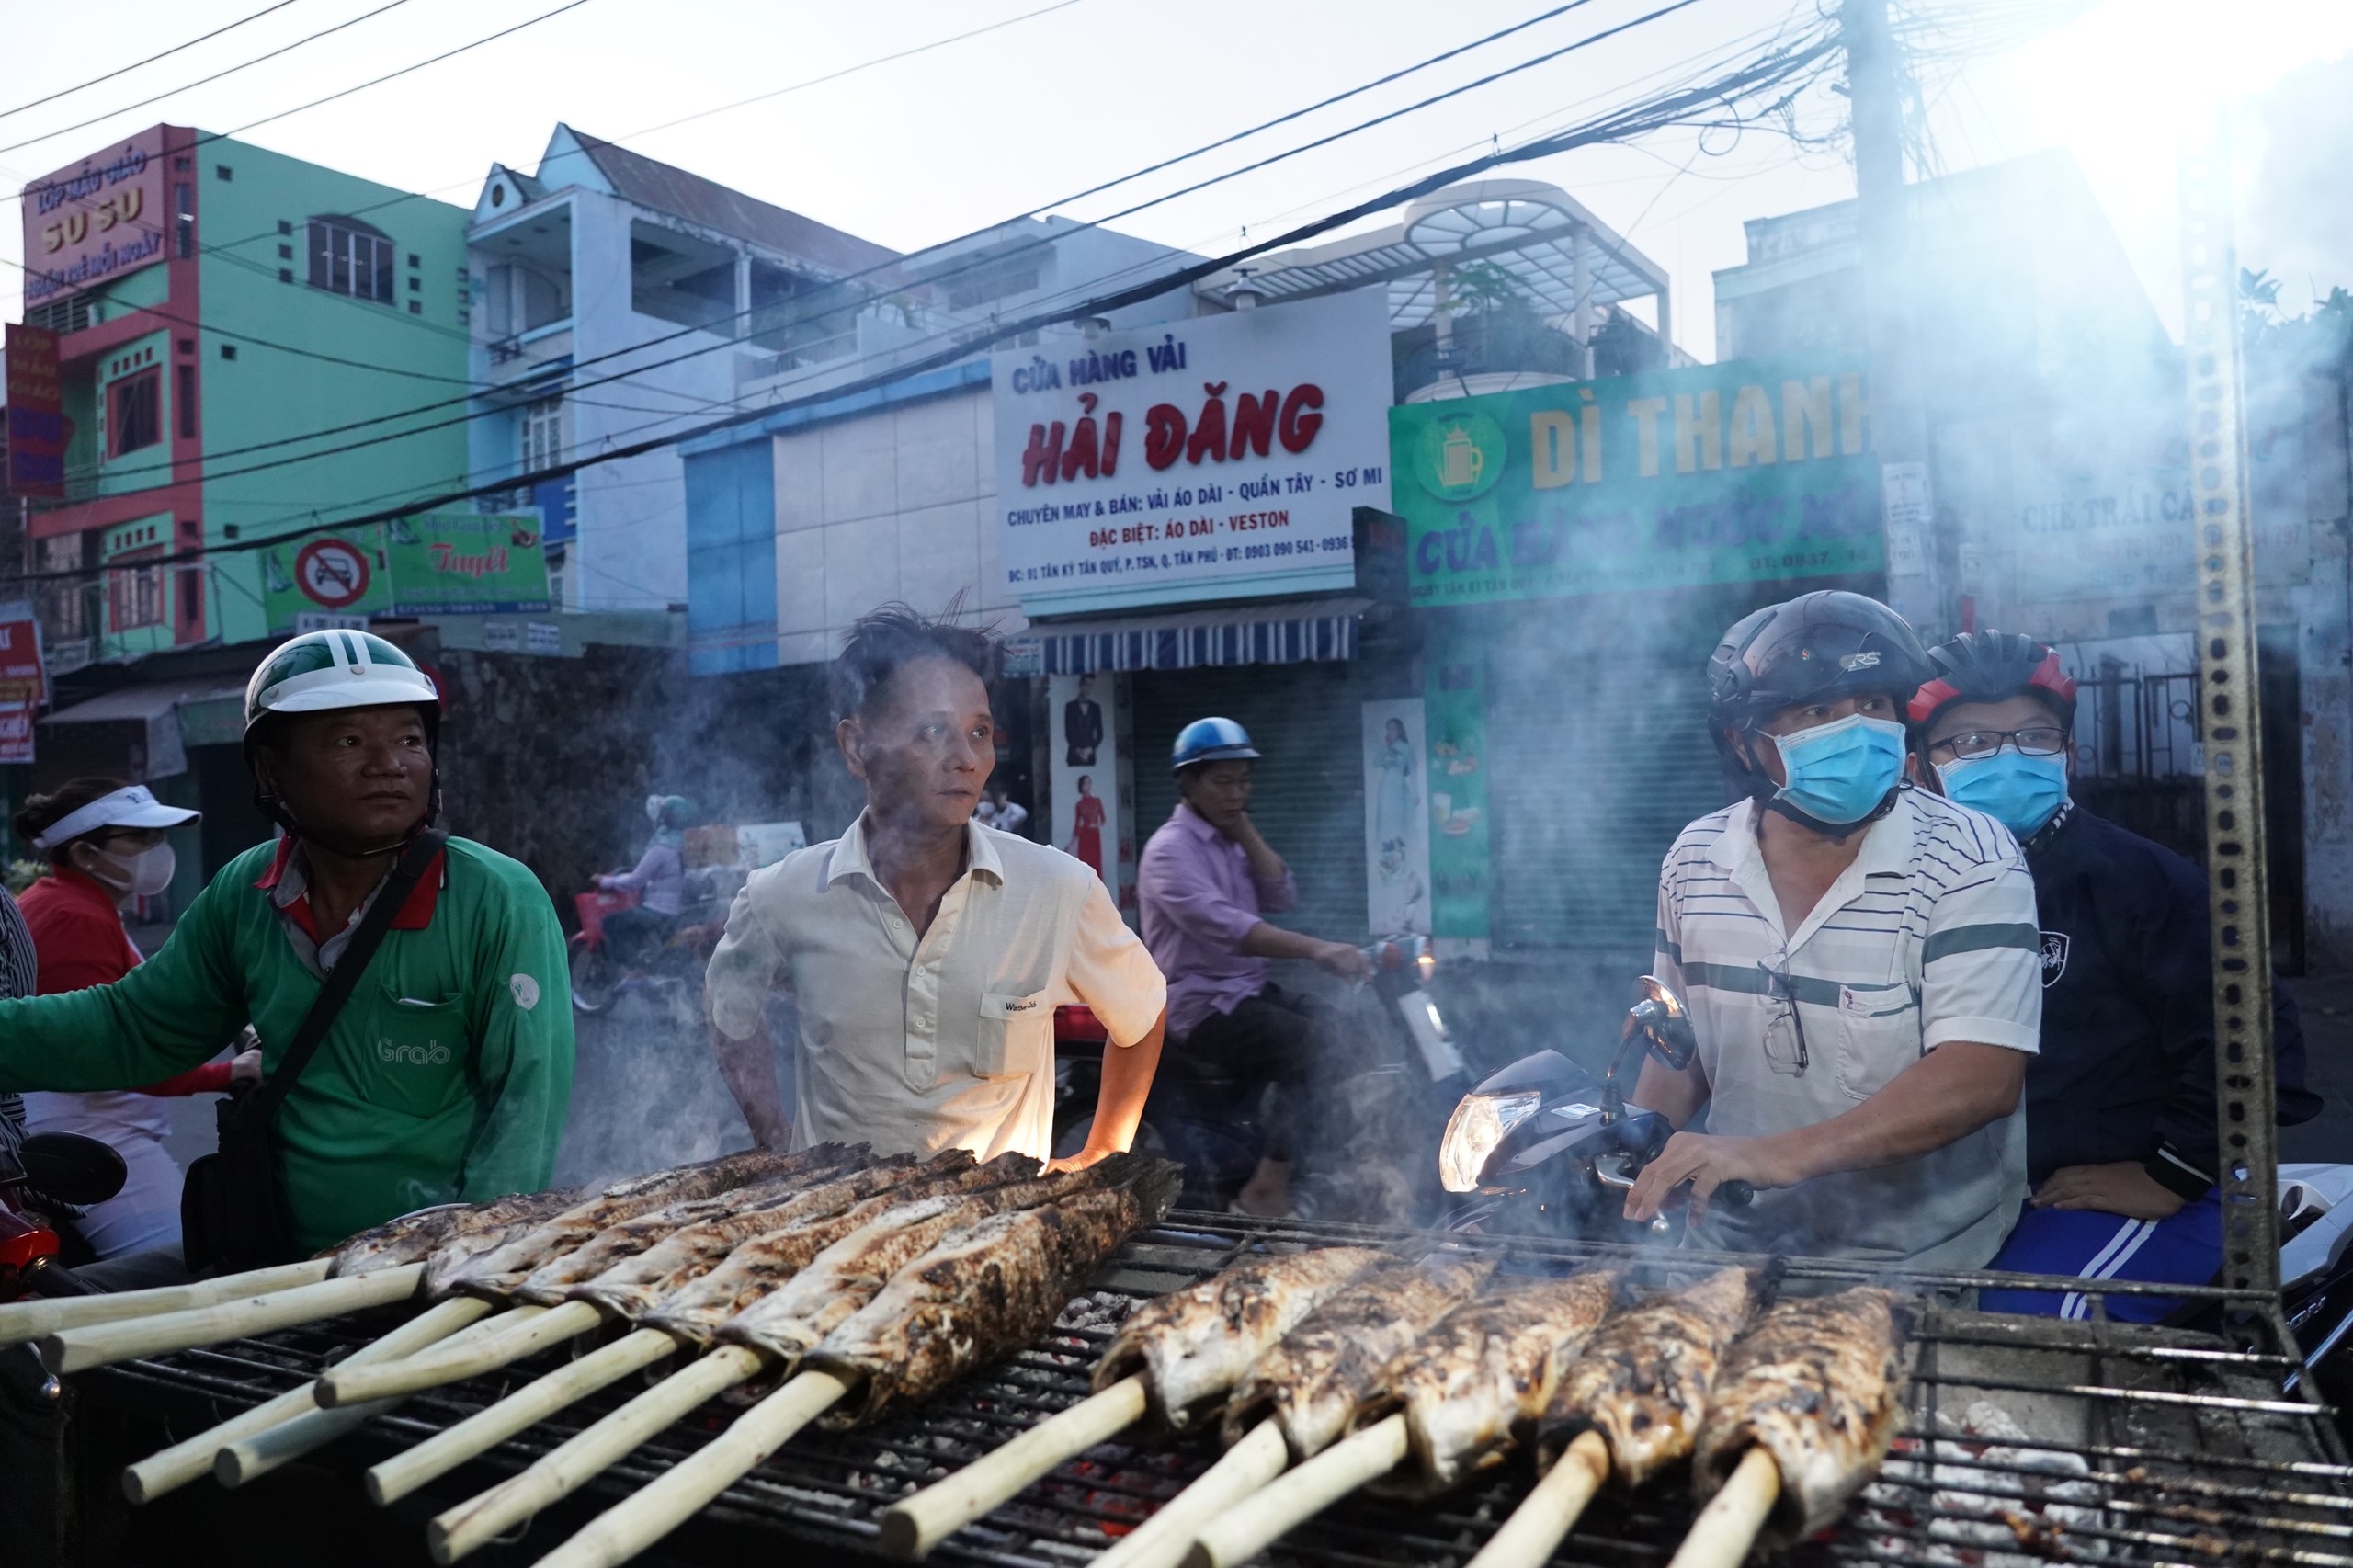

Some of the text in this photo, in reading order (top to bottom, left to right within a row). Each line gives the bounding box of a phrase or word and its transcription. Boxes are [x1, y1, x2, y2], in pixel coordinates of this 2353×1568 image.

[41, 186, 142, 255] SU SU
[1013, 334, 1187, 394] CỬA HÀNG VẢI
[1022, 381, 1324, 487] HẢI ĐĂNG
[1530, 388, 1602, 491] DÌ
[1007, 504, 1060, 527] CHUYÊN
[1063, 501, 1092, 520] MAY
[1095, 500, 1105, 517] &
[1109, 494, 1142, 515] BÁN:
[1147, 487, 1169, 509] VẢI
[1173, 486, 1193, 507] ÁO
[1199, 483, 1222, 505] DÀI
[1285, 472, 1313, 494] TÂY
[1335, 467, 1358, 489] SƠ
[1363, 467, 1382, 486] MI
[2161, 480, 2198, 522] CÂ
[1041, 562, 1059, 579] TÂN
[1079, 558, 1097, 576] TÂN
[1174, 550, 1194, 566] TÂN
[1296, 540, 1314, 553] 541
[1089, 528, 1117, 550] ĐẶC
[1122, 522, 1159, 547] BIỆT:
[1165, 518, 1184, 539] ÁO
[1190, 515, 1213, 536] DÀI
[1229, 510, 1290, 532] VESTON
[1416, 510, 1499, 574] CỬA
[377, 1037, 451, 1065] Grab
